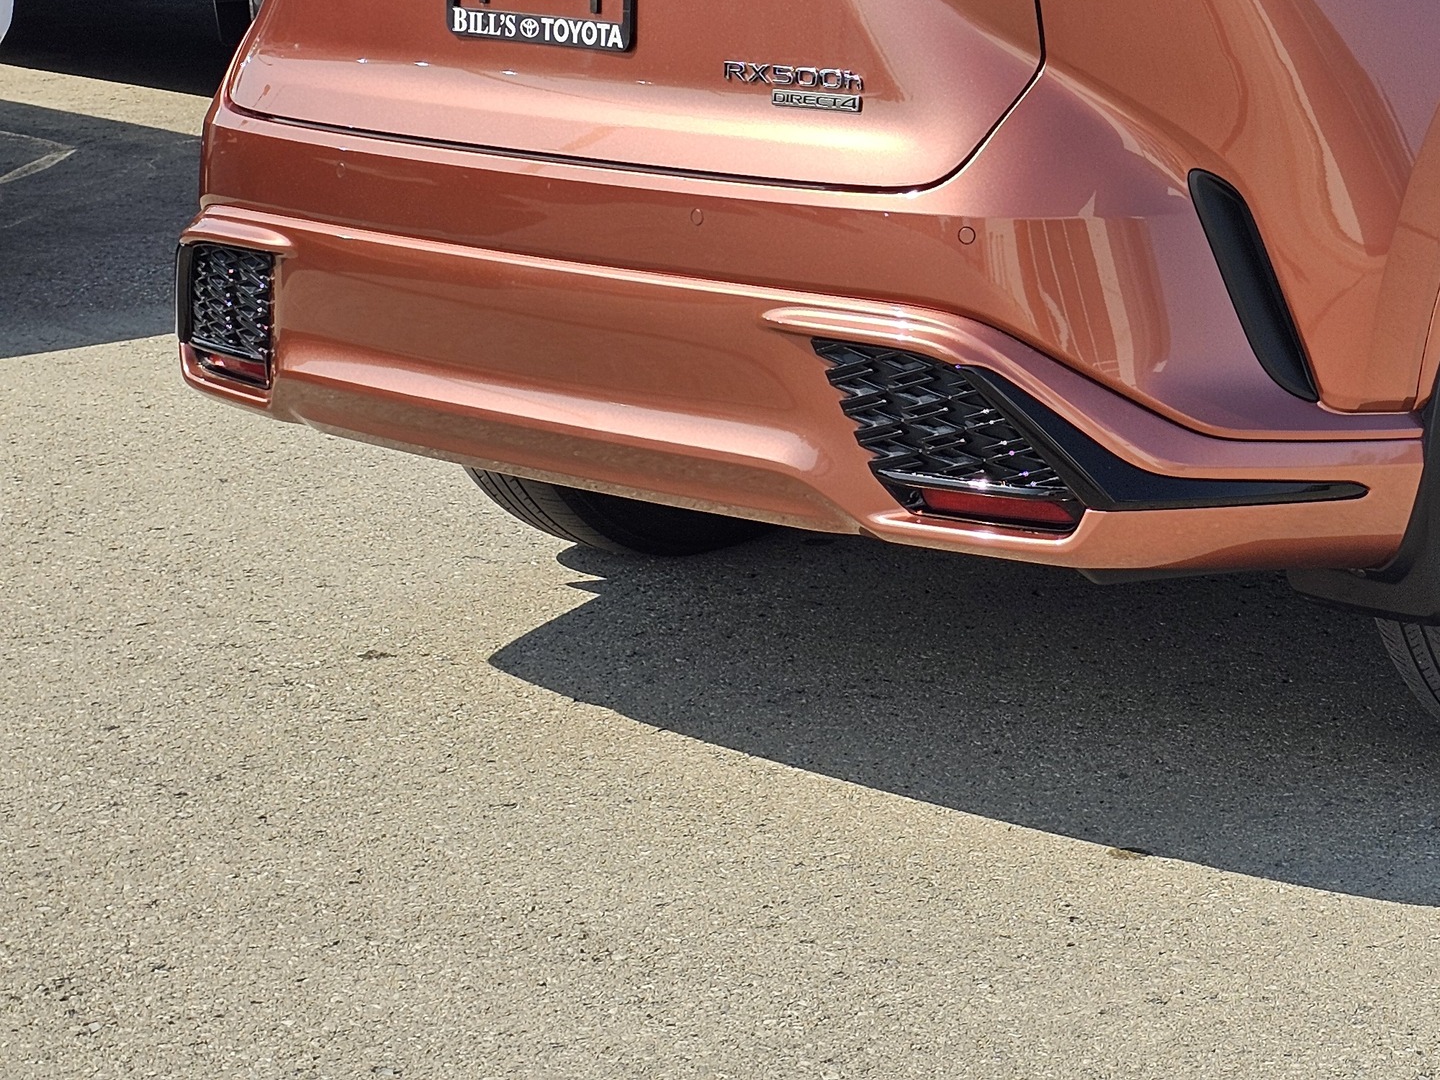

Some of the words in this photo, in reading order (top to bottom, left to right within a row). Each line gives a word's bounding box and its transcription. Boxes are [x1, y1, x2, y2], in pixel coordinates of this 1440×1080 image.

[451, 6, 517, 38] BILL'S
[541, 17, 624, 49] TOYOTA
[723, 59, 864, 92] RX500h
[773, 91, 858, 110] DIRECT4
